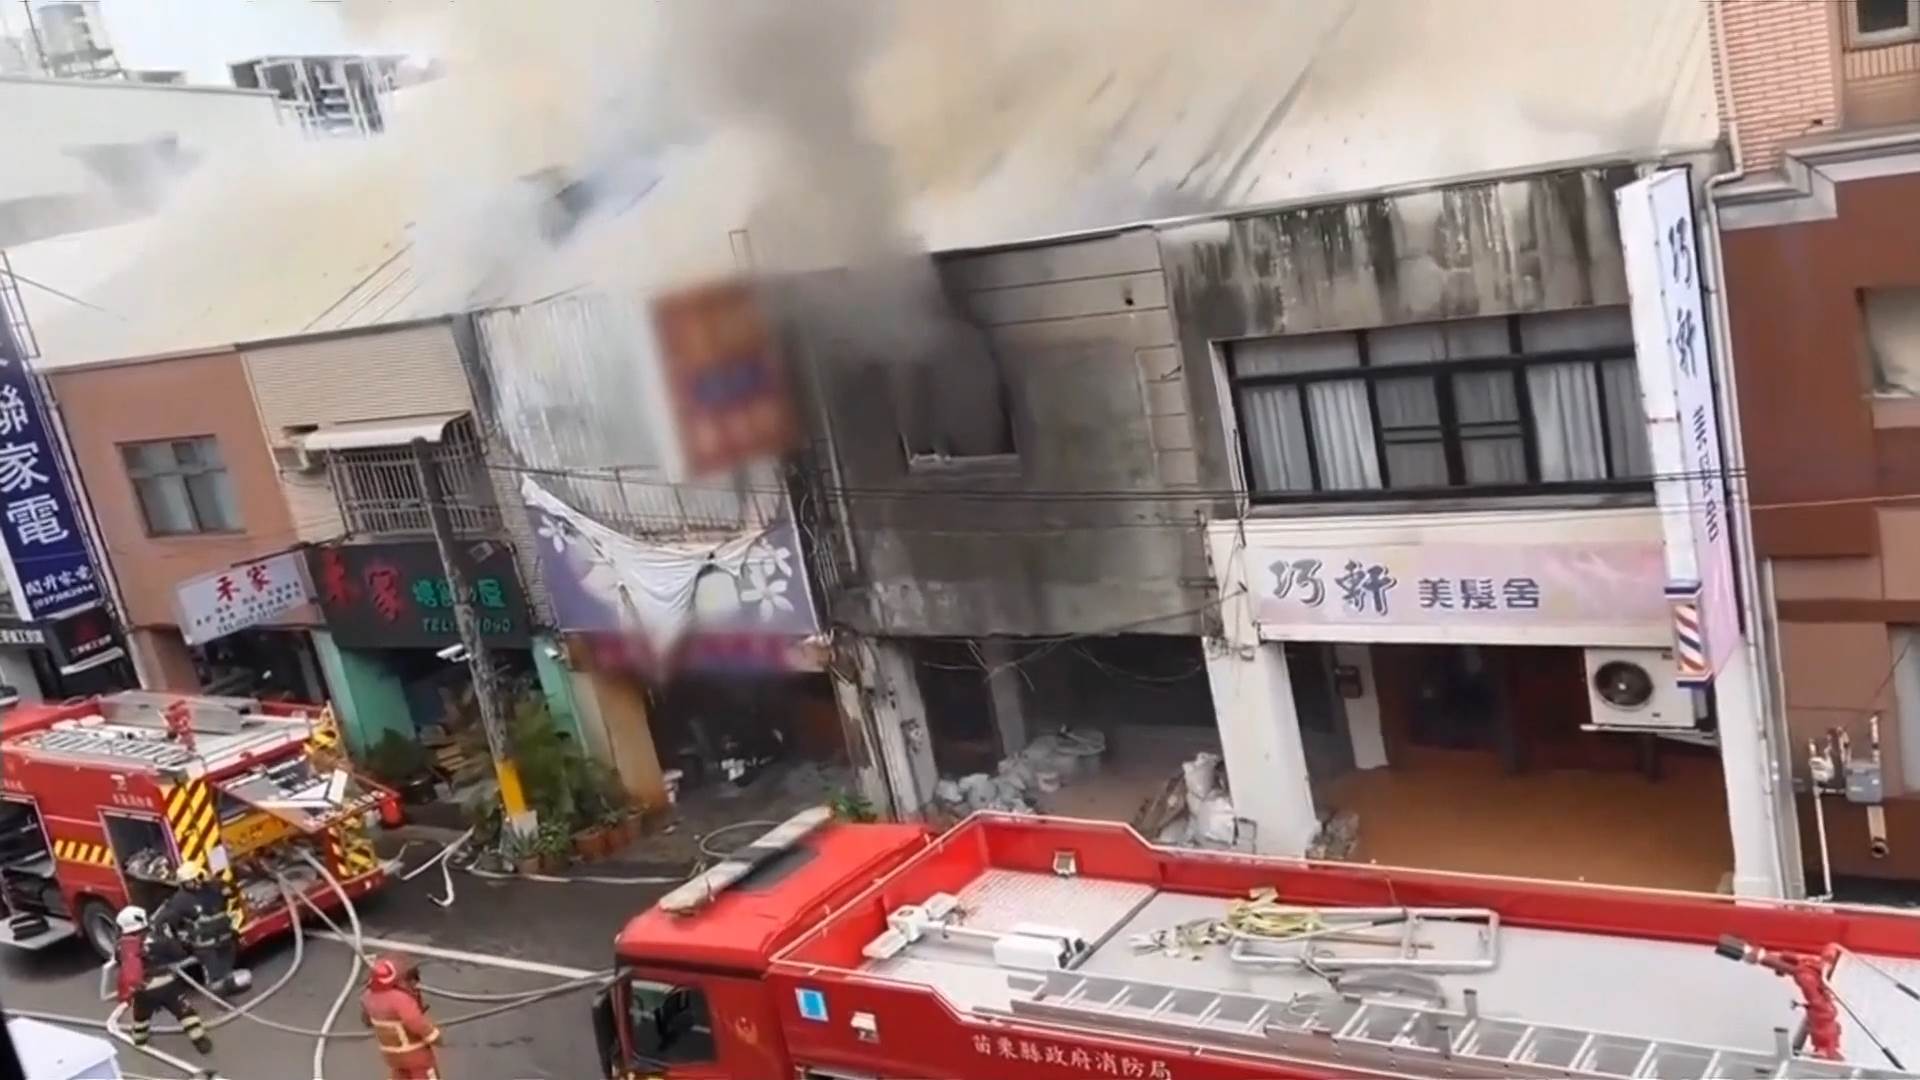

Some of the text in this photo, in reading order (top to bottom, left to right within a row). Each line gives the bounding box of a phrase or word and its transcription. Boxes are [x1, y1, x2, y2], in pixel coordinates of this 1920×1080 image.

[216, 565, 272, 602] 禾家
[1268, 558, 1541, 615] 巧軒 美髮舍
[971, 1034, 1172, 1080] 苗栗縣政府消防局
